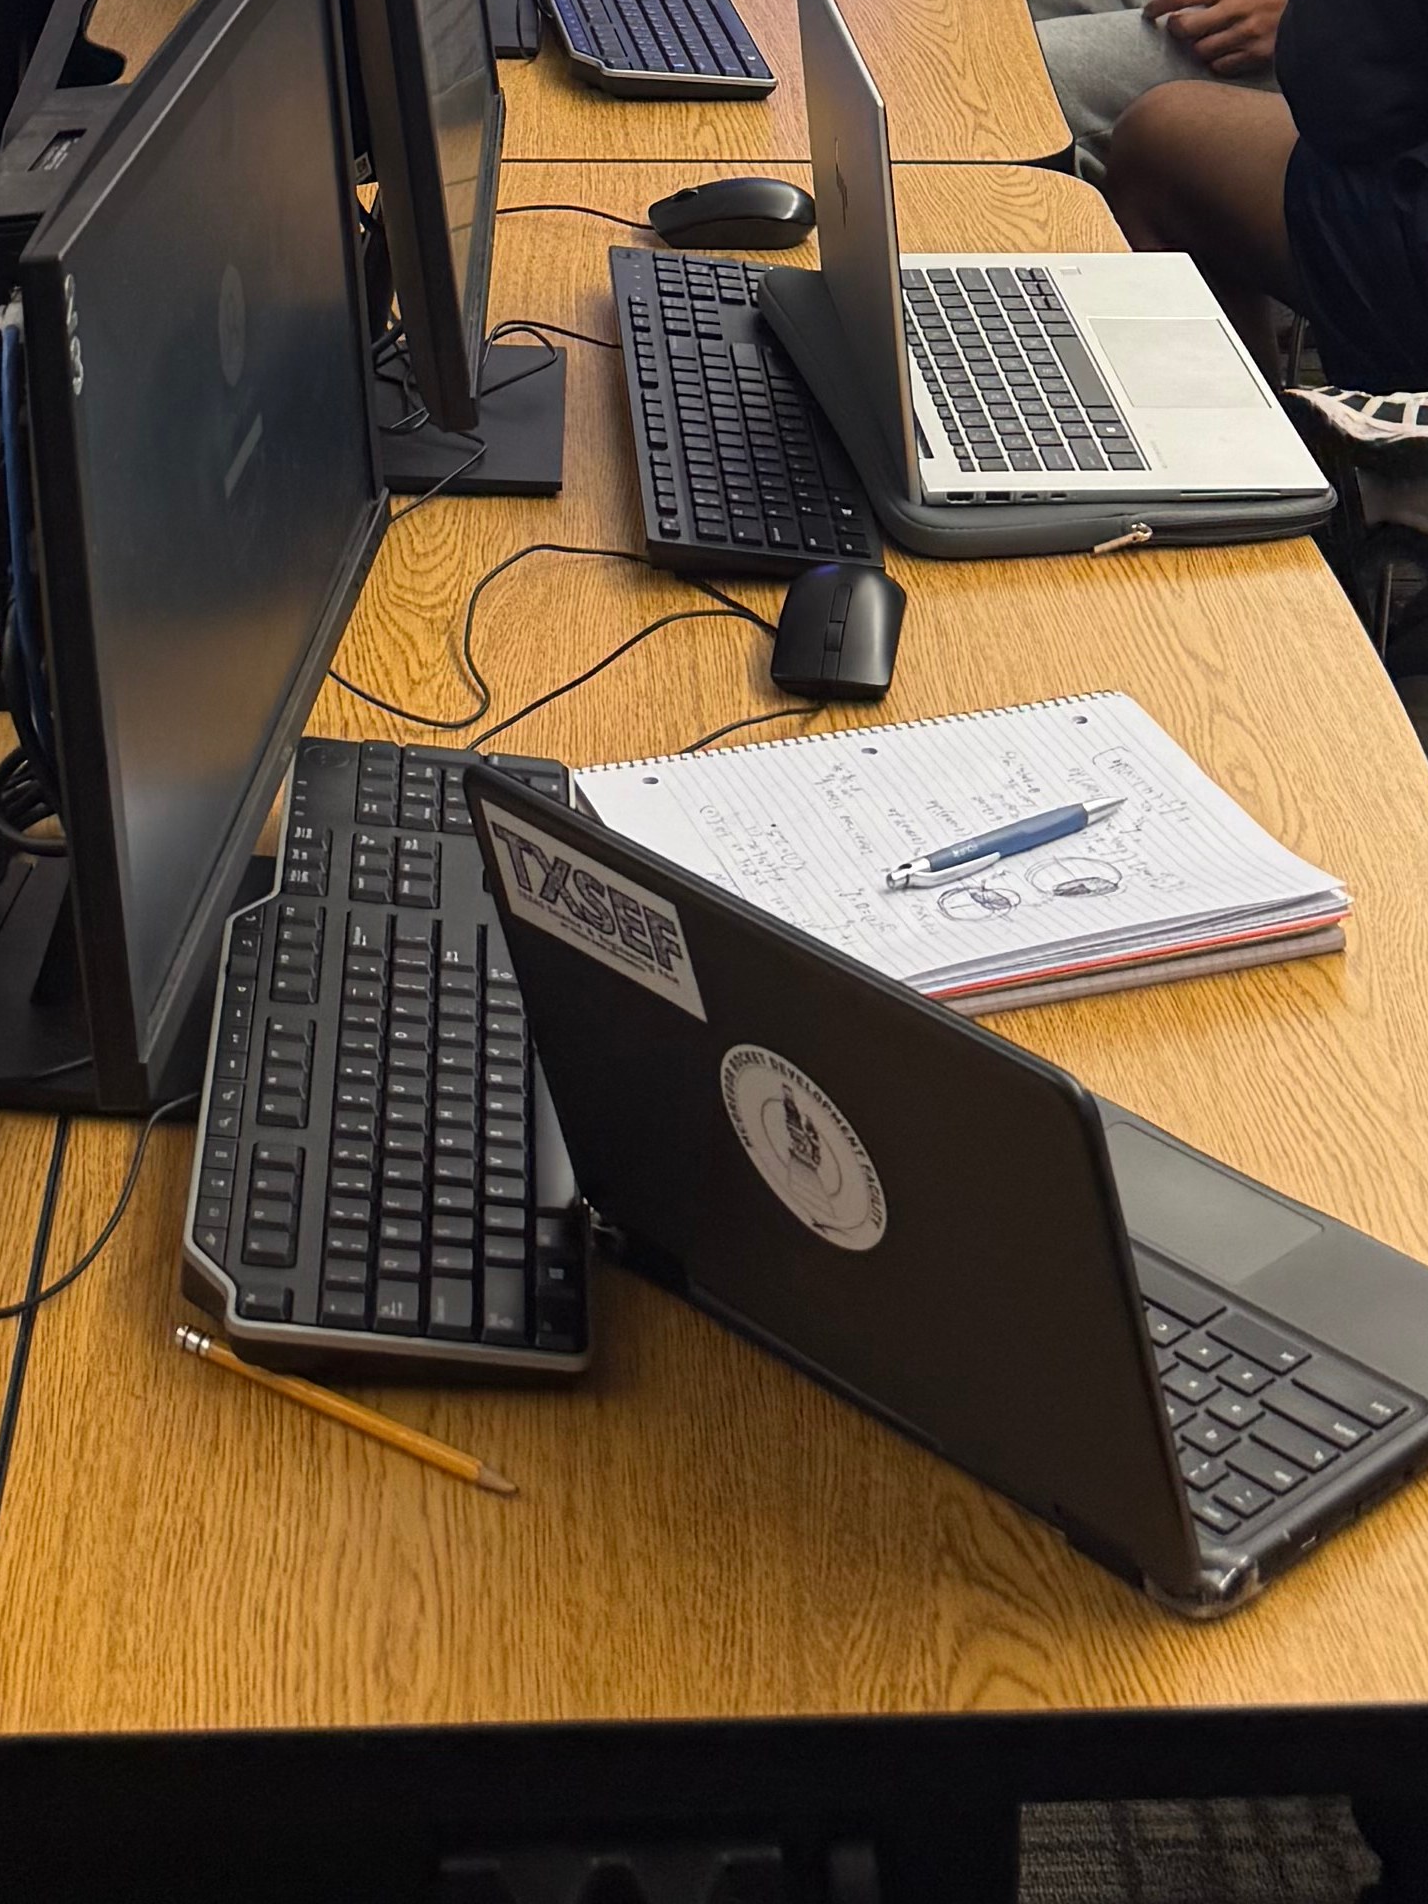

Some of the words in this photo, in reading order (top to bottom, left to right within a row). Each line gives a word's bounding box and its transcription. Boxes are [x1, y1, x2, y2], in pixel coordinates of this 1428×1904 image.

[491, 821, 684, 972] TXSEF
[728, 1050, 767, 1073] ROCKET
[768, 1056, 866, 1163] DEVELOPMENT
[862, 1163, 883, 1230] FACILITY
